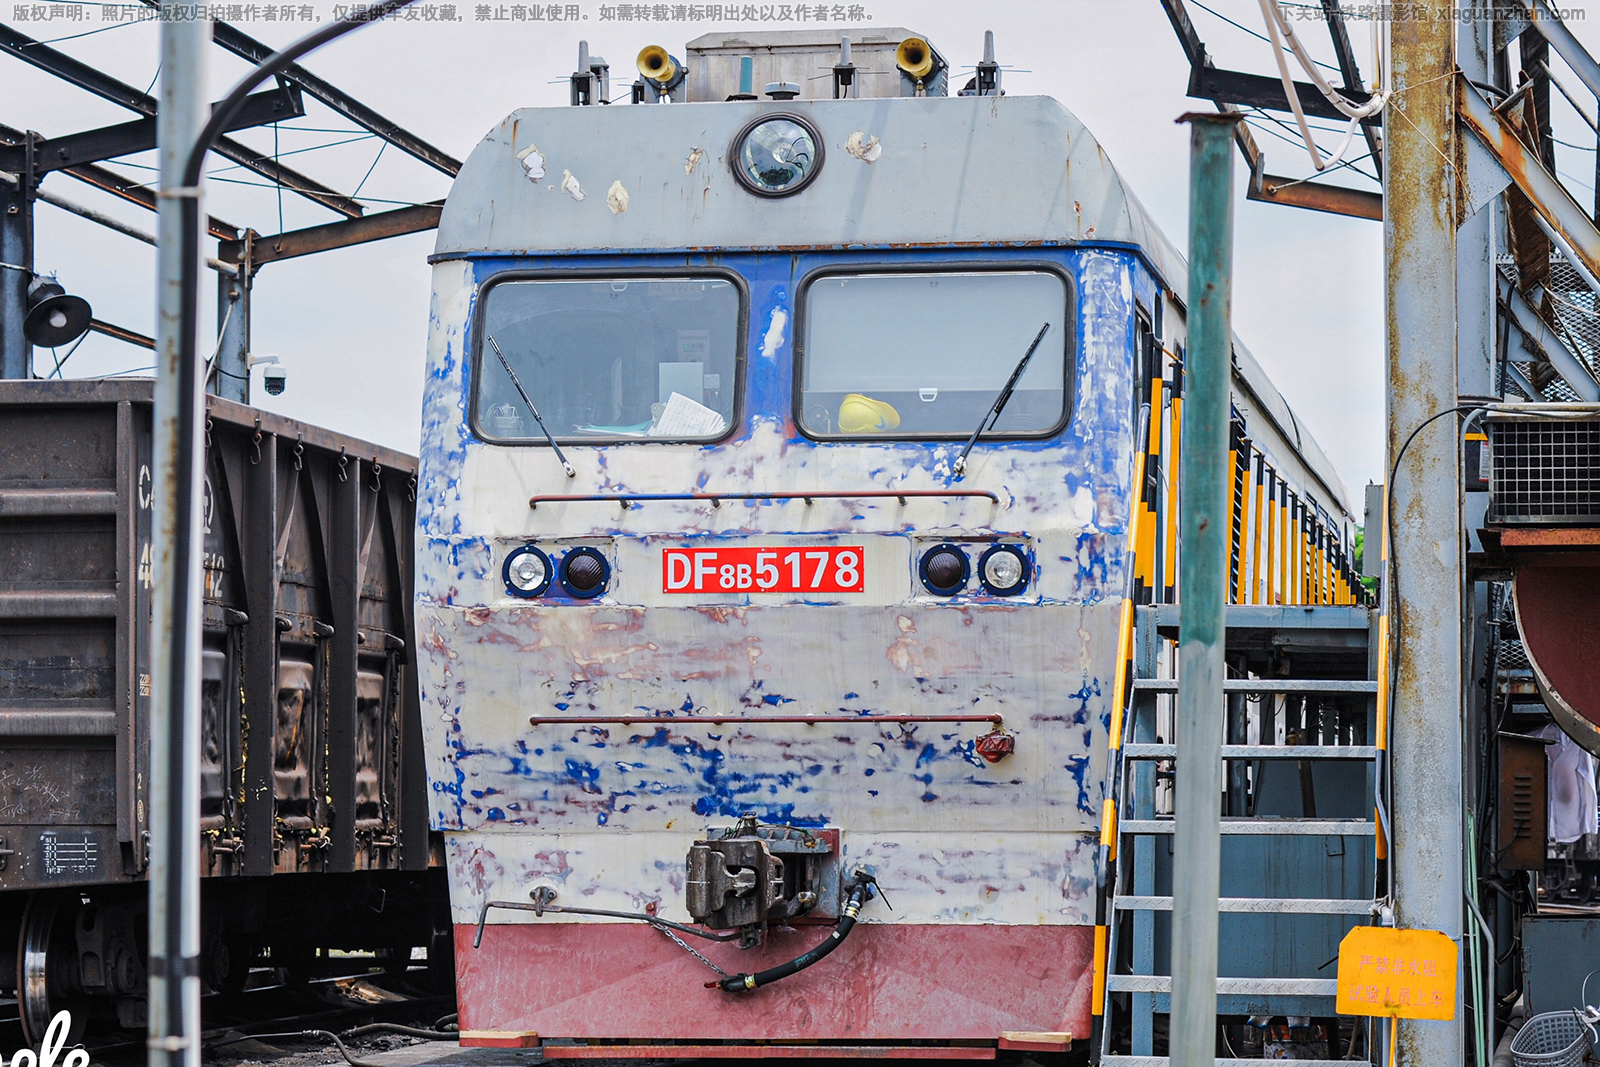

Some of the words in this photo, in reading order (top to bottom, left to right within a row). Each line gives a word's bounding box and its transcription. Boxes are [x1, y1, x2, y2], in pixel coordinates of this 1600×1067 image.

[667, 551, 860, 590] DF8B5178
[1358, 954, 1438, 977] 严禁非水阻
[1348, 983, 1444, 1008] 试验人员上车
